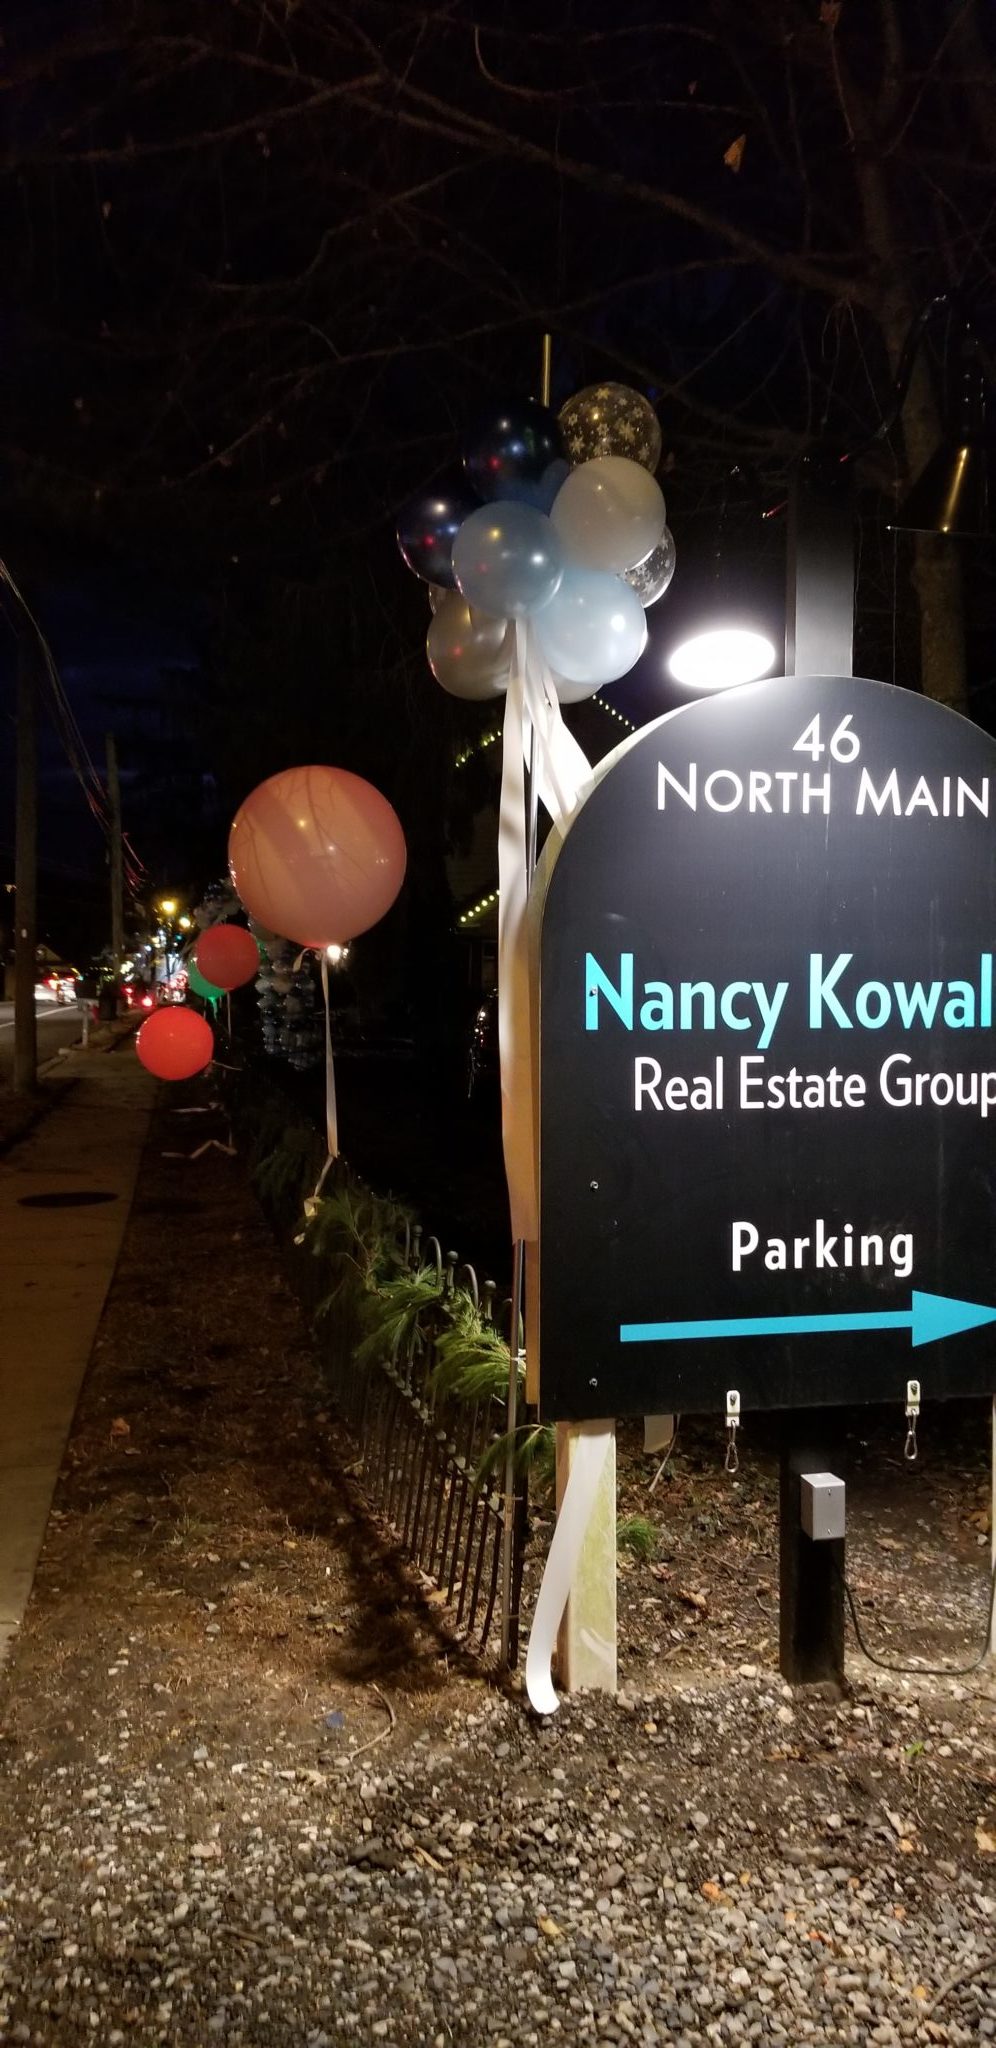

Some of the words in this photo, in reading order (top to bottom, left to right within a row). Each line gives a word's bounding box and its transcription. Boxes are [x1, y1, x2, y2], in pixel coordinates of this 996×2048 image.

[792, 714, 861, 764] 46
[656, 761, 832, 815] NORTH
[855, 767, 990, 818] MAIN
[585, 953, 790, 1050] Nancy
[634, 1055, 724, 1111] Real
[739, 1055, 867, 1110] Estate
[879, 1053, 996, 1118] Group
[732, 1218, 914, 1278] Parking
